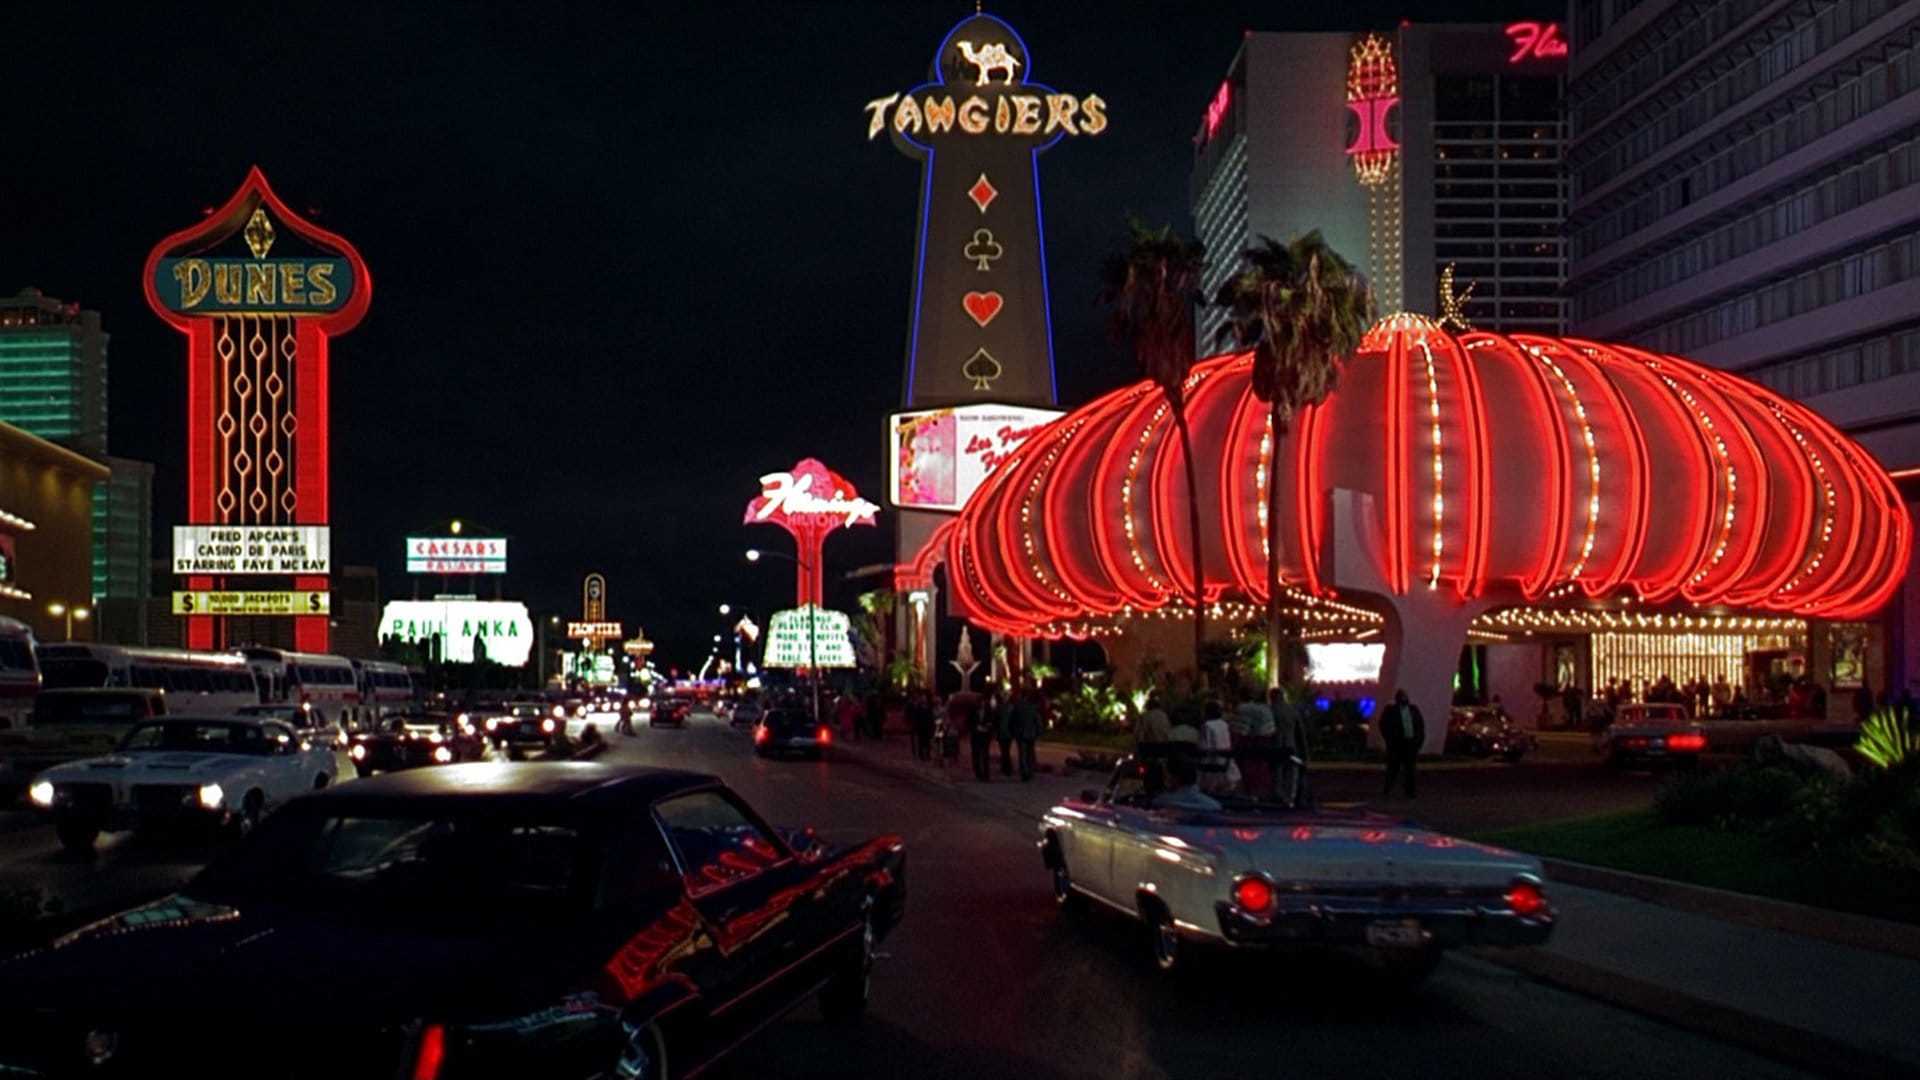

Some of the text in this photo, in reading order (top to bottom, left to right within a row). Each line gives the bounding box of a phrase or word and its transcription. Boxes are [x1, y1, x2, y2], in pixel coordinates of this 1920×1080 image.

[173, 257, 337, 310] DUNES
[757, 471, 881, 528] Flamingo
[210, 530, 299, 543] FRED APCAR'S
[198, 545, 307, 557] CASINO DE PARIS
[416, 542, 498, 556] CAESARS
[177, 559, 236, 571] STARRING
[243, 559, 274, 571] FAYE
[182, 594, 195, 612] $
[309, 593, 321, 612] $
[789, 615, 833, 623] FLAMNGO
[393, 618, 519, 638] PAUL ANKA
[567, 621, 622, 638] FRONTIER
[806, 633, 845, 641] BNEFITS
